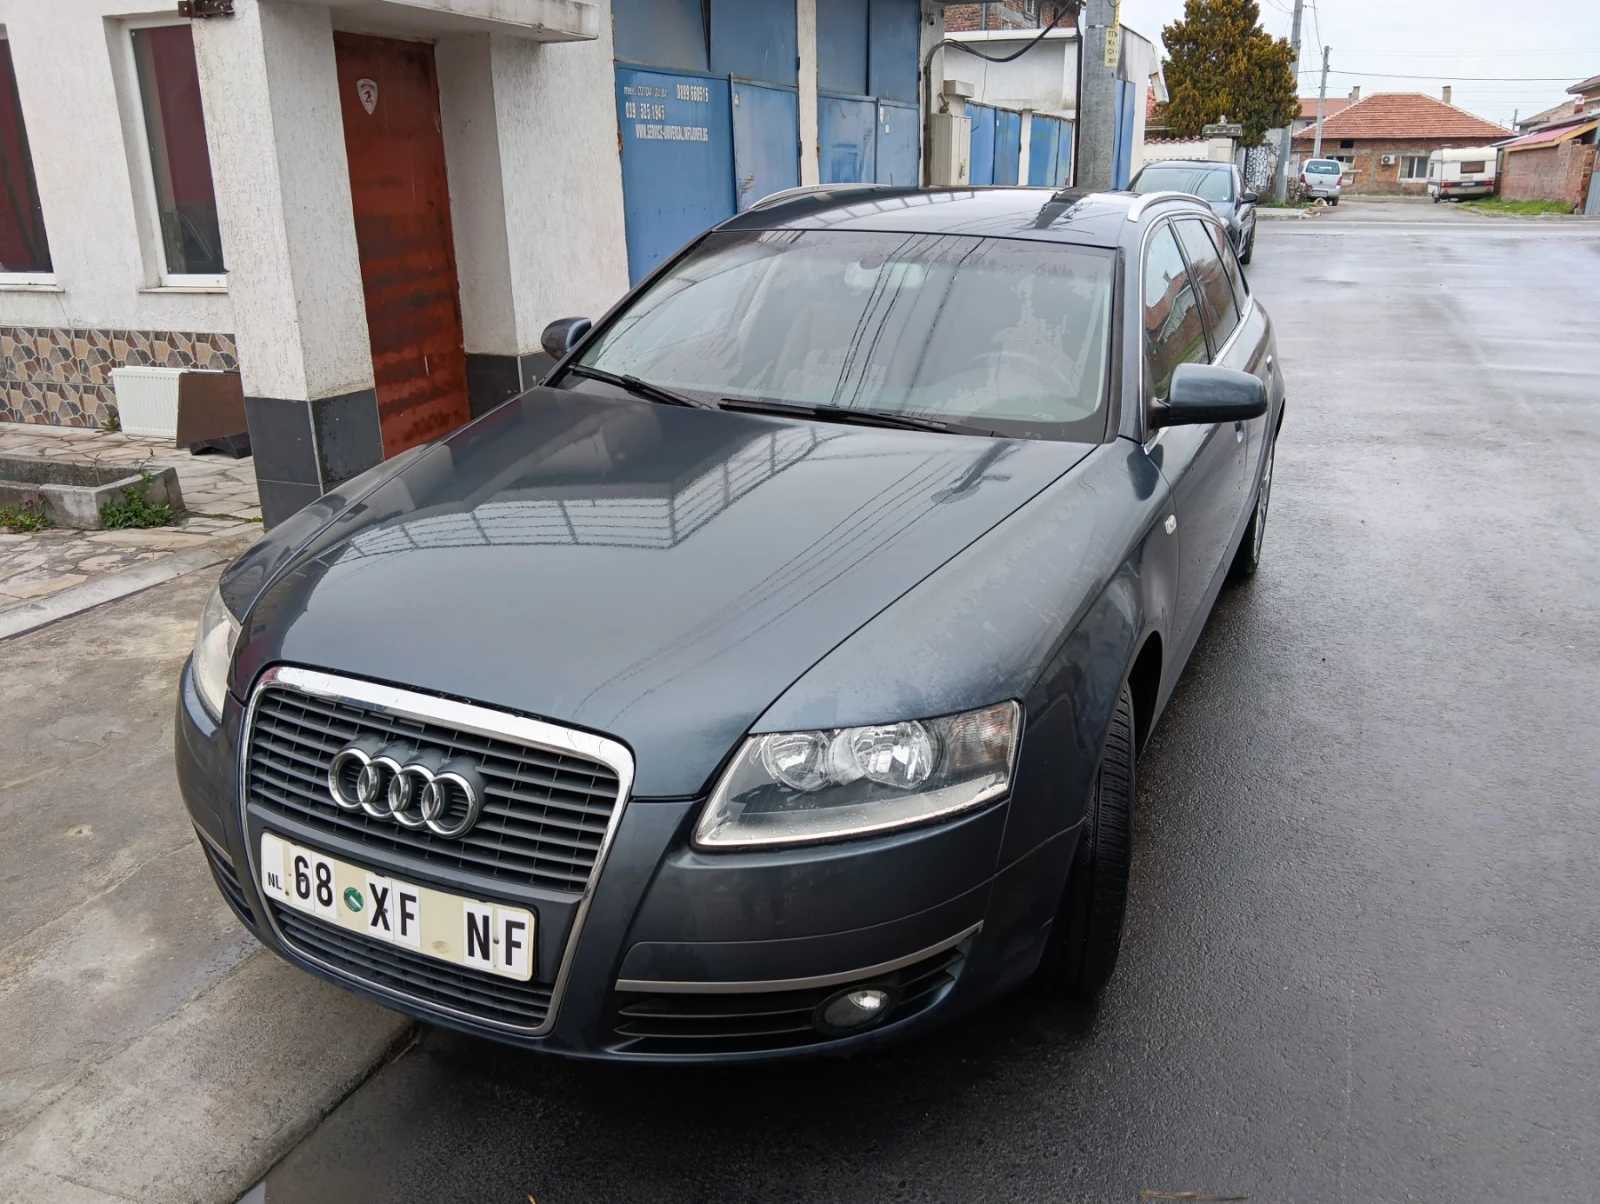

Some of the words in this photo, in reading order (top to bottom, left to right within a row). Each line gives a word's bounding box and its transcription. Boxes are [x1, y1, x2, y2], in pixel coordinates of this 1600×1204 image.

[267, 872, 282, 890] NL
[294, 855, 333, 907] 68
[369, 882, 417, 937] XF
[466, 911, 526, 967] NF
